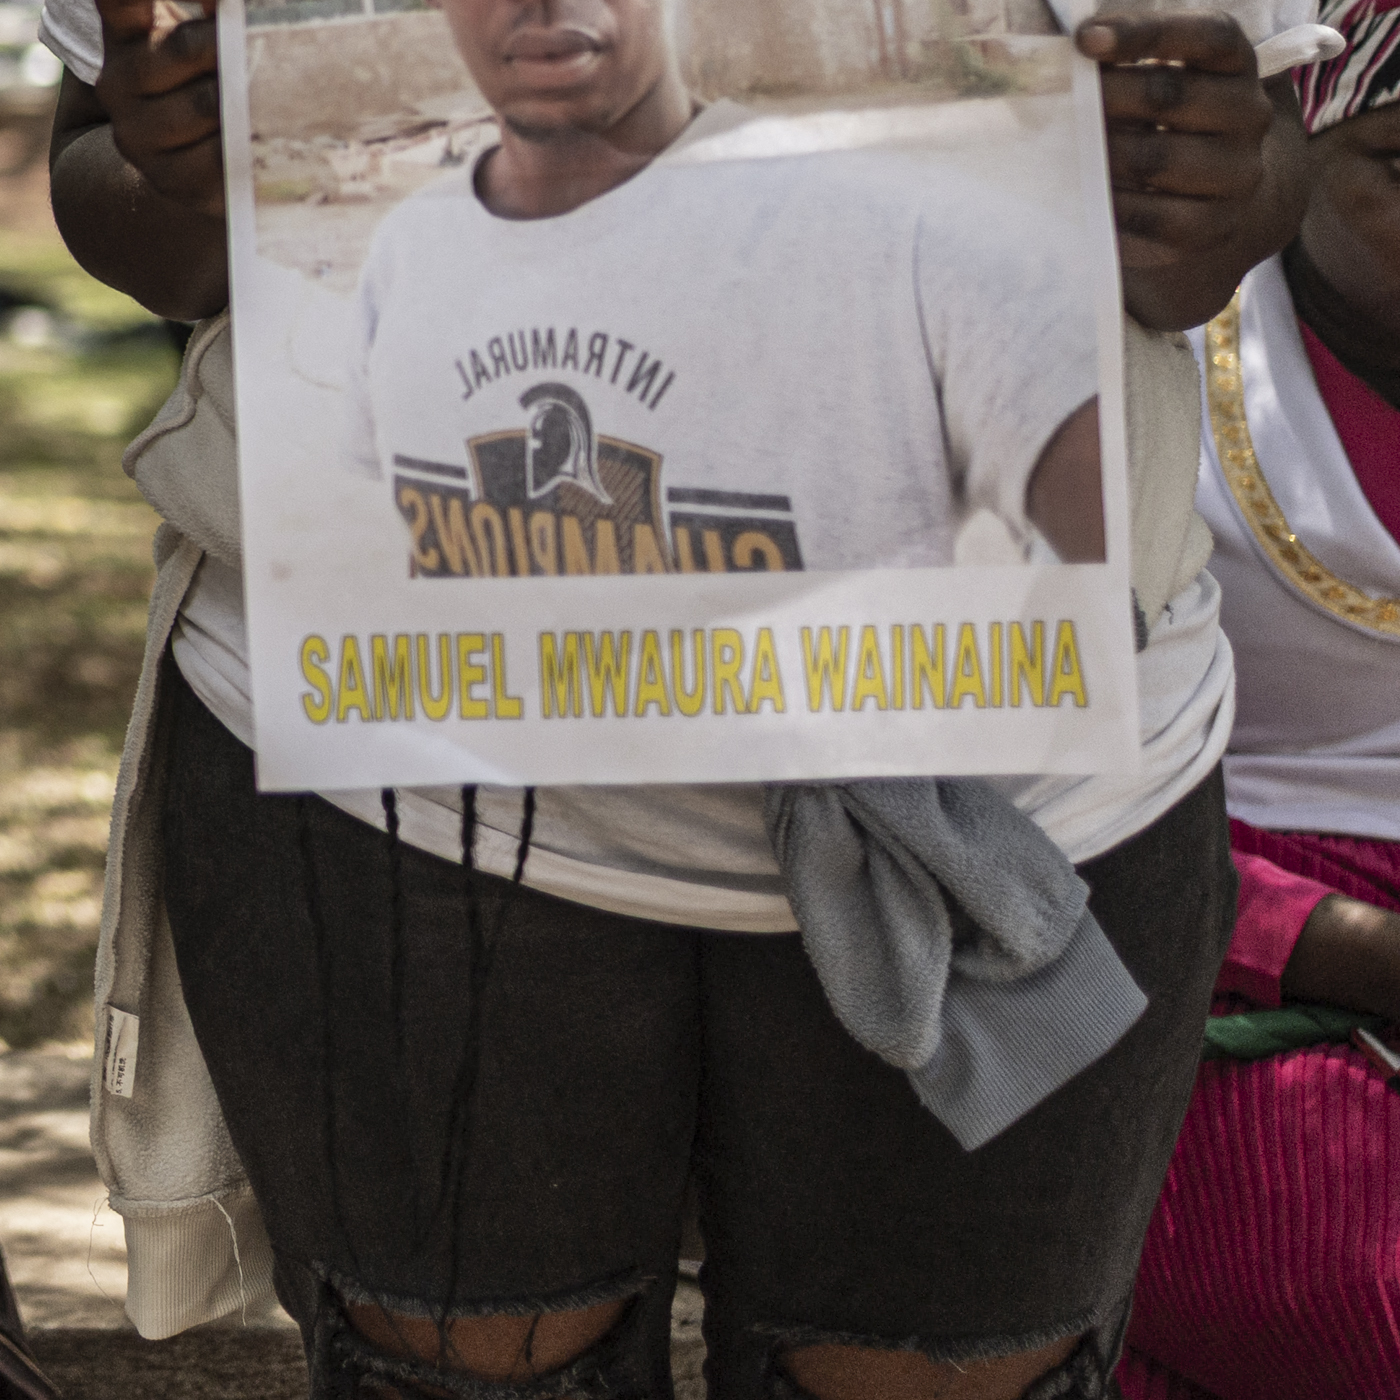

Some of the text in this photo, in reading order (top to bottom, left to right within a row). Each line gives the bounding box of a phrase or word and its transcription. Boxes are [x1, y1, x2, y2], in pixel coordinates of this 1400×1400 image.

[297, 618, 1091, 725] SAMUEL MWAURA WAINAINA
